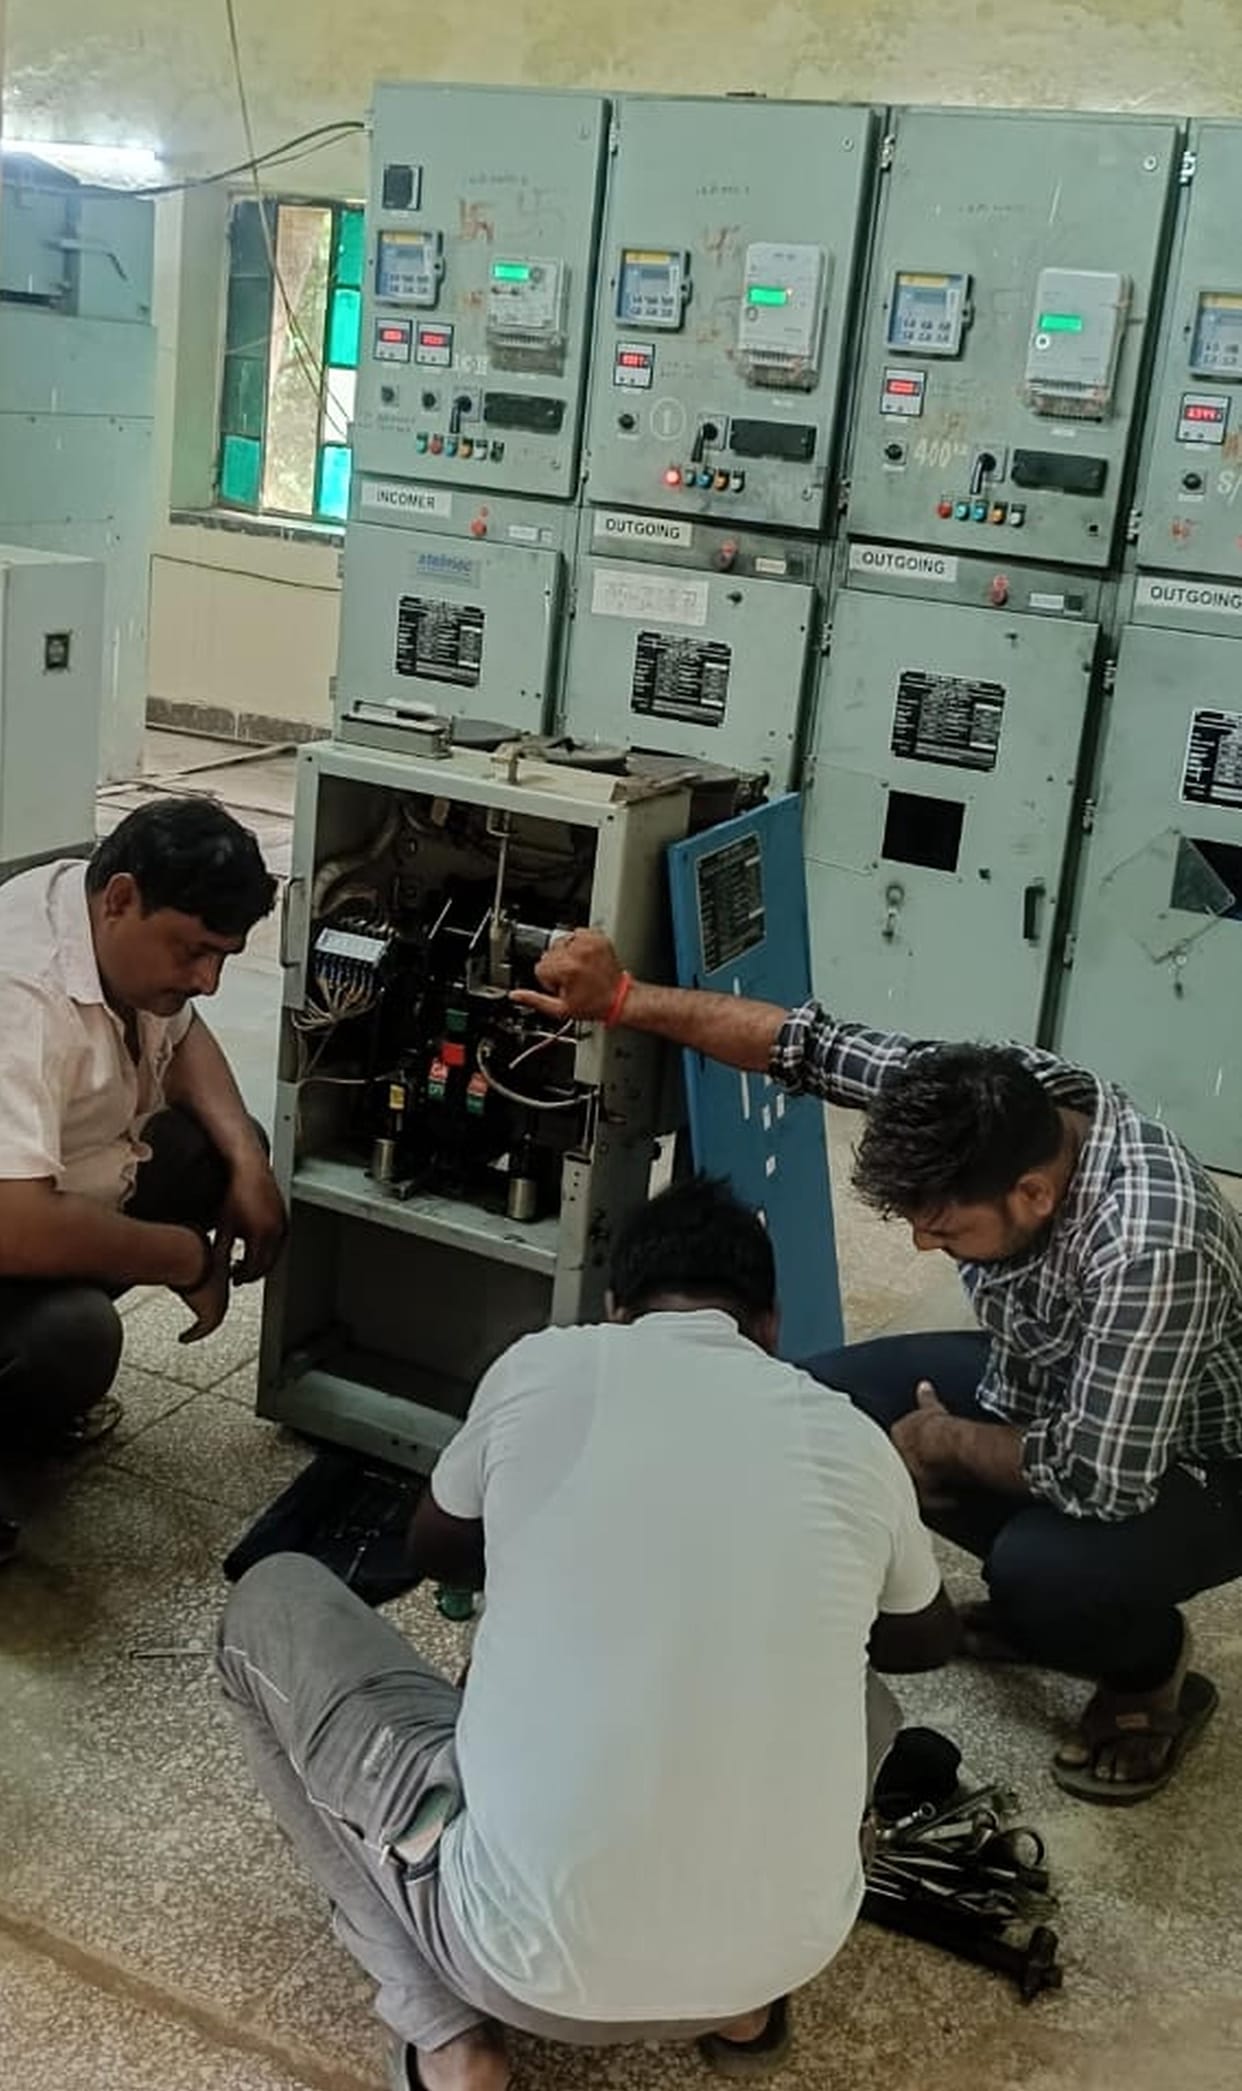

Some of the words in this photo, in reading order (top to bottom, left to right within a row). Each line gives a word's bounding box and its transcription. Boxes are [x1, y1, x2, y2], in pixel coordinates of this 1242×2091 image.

[376, 489, 436, 511] INCOMER
[605, 518, 680, 540] OUTGOING
[861, 551, 946, 575] OUTGOING
[1150, 585, 1242, 610] OUTGOING
